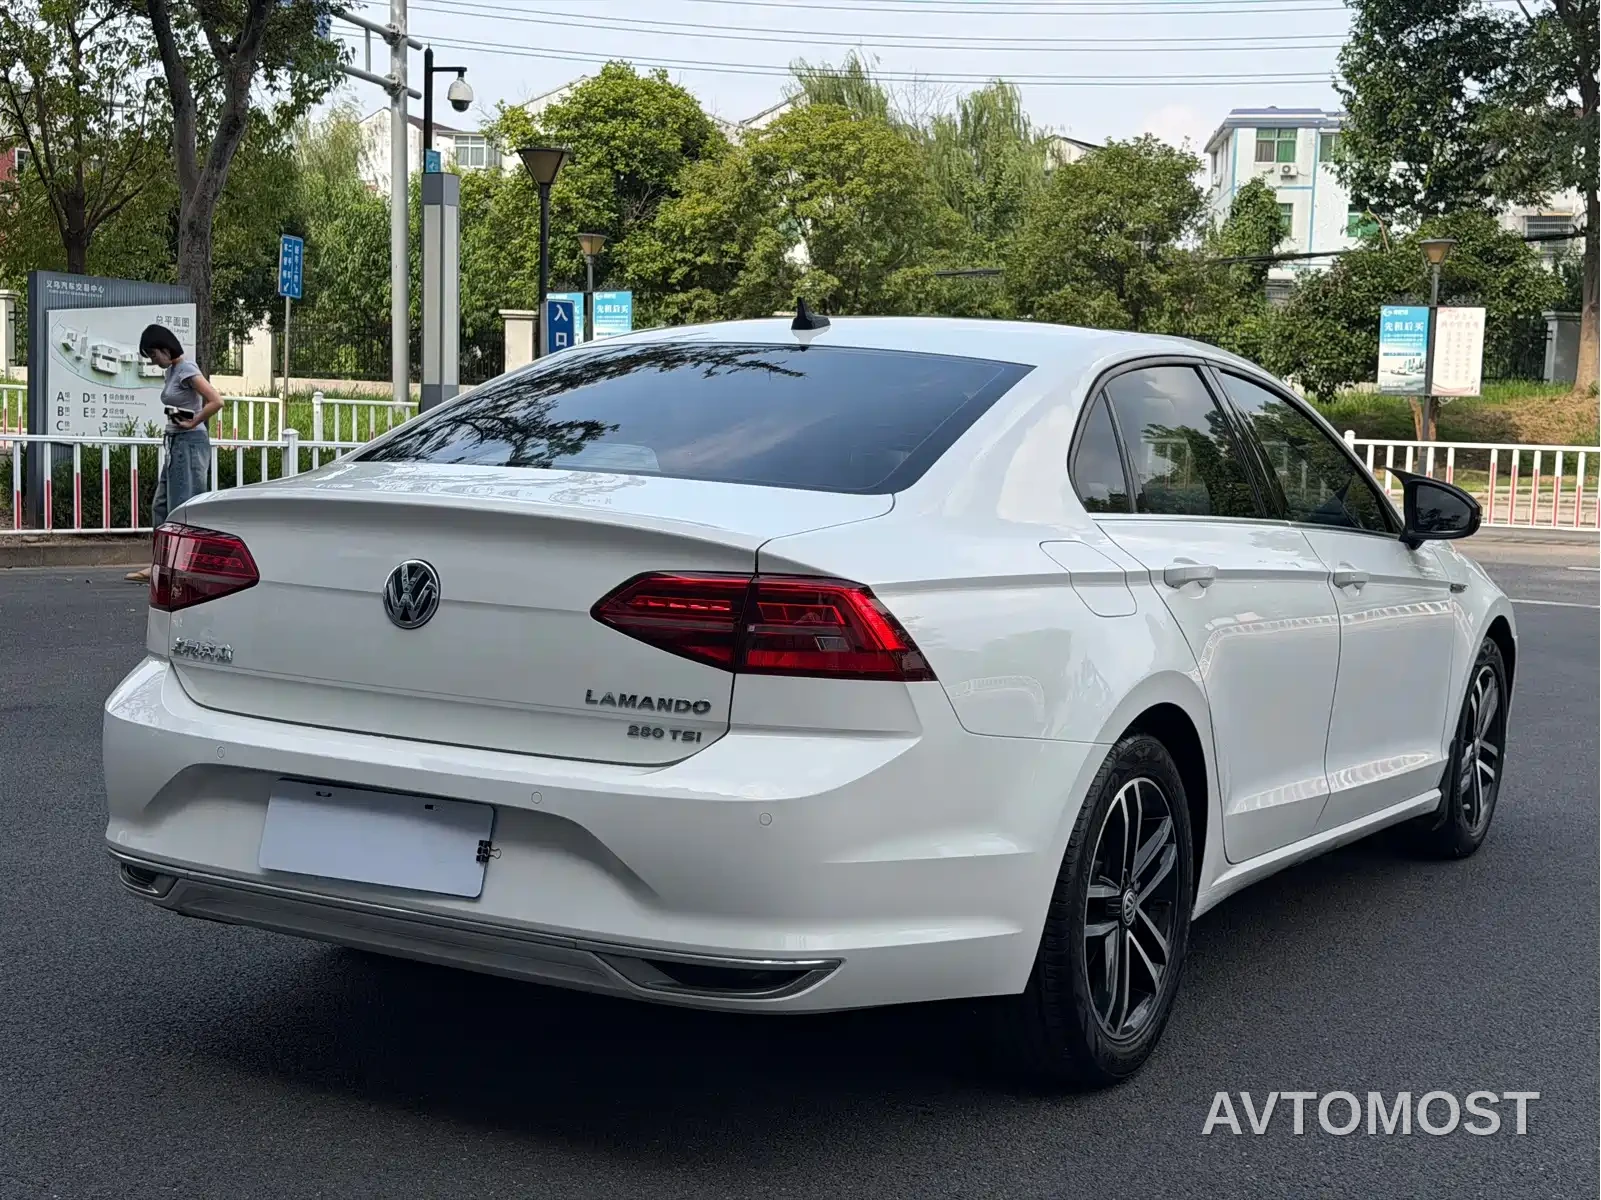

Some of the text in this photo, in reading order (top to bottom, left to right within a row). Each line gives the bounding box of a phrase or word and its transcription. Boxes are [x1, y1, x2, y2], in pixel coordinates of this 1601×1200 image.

[156, 315, 190, 328] 总平面图
[554, 304, 569, 347] 入口
[56, 391, 64, 402] A
[82, 392, 90, 403] D
[103, 393, 107, 404] 1
[57, 406, 64, 417] B
[83, 407, 89, 418] E
[102, 407, 108, 418] 2
[56, 420, 64, 431] C
[102, 421, 108, 432] 3
[584, 688, 712, 715] LAMANDO
[669, 729, 703, 743] TSI
